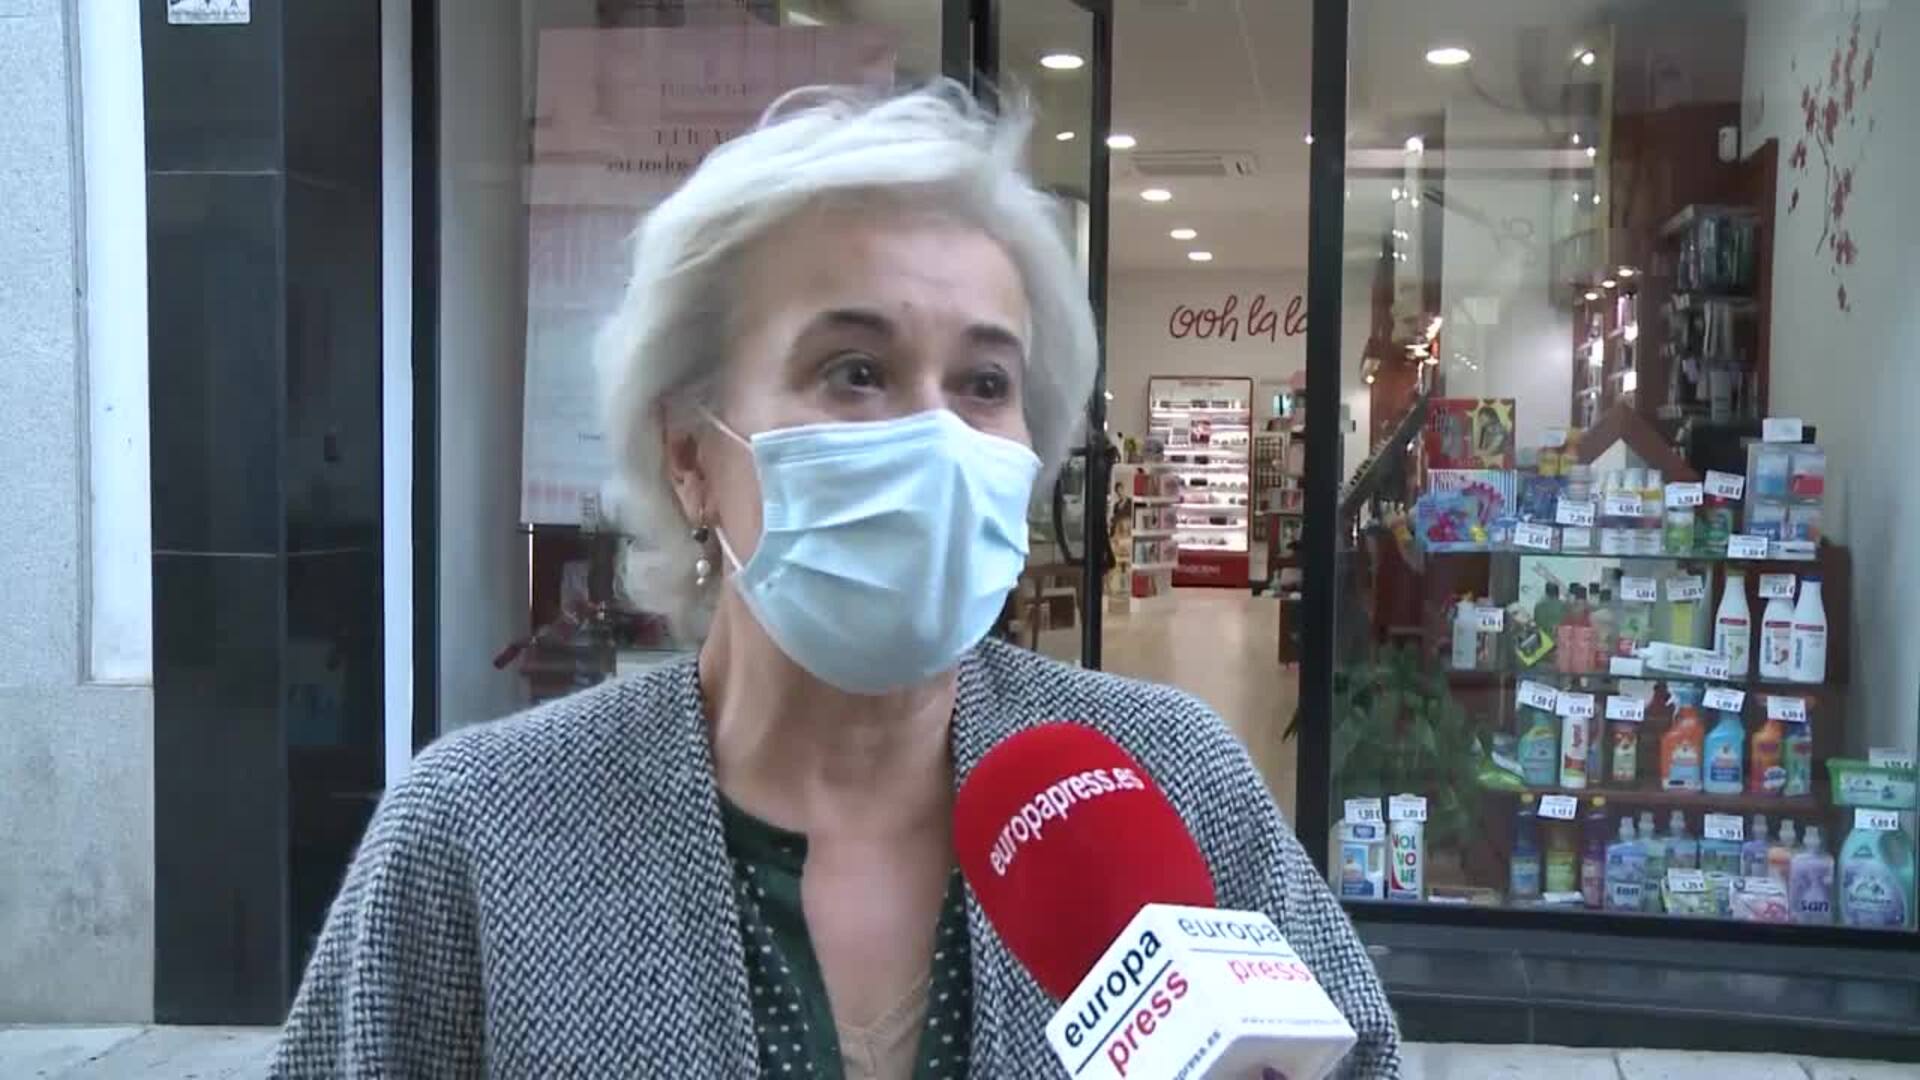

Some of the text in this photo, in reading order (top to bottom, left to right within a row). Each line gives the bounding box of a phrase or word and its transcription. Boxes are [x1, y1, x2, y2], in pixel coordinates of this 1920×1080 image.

[1169, 294, 1239, 342] ooh
[1247, 294, 1279, 342] la
[990, 767, 1145, 876] europapress.es
[1178, 918, 1281, 947] europa
[1065, 930, 1161, 1048] europa
[1226, 960, 1311, 984] press
[1108, 971, 1189, 1077] press
